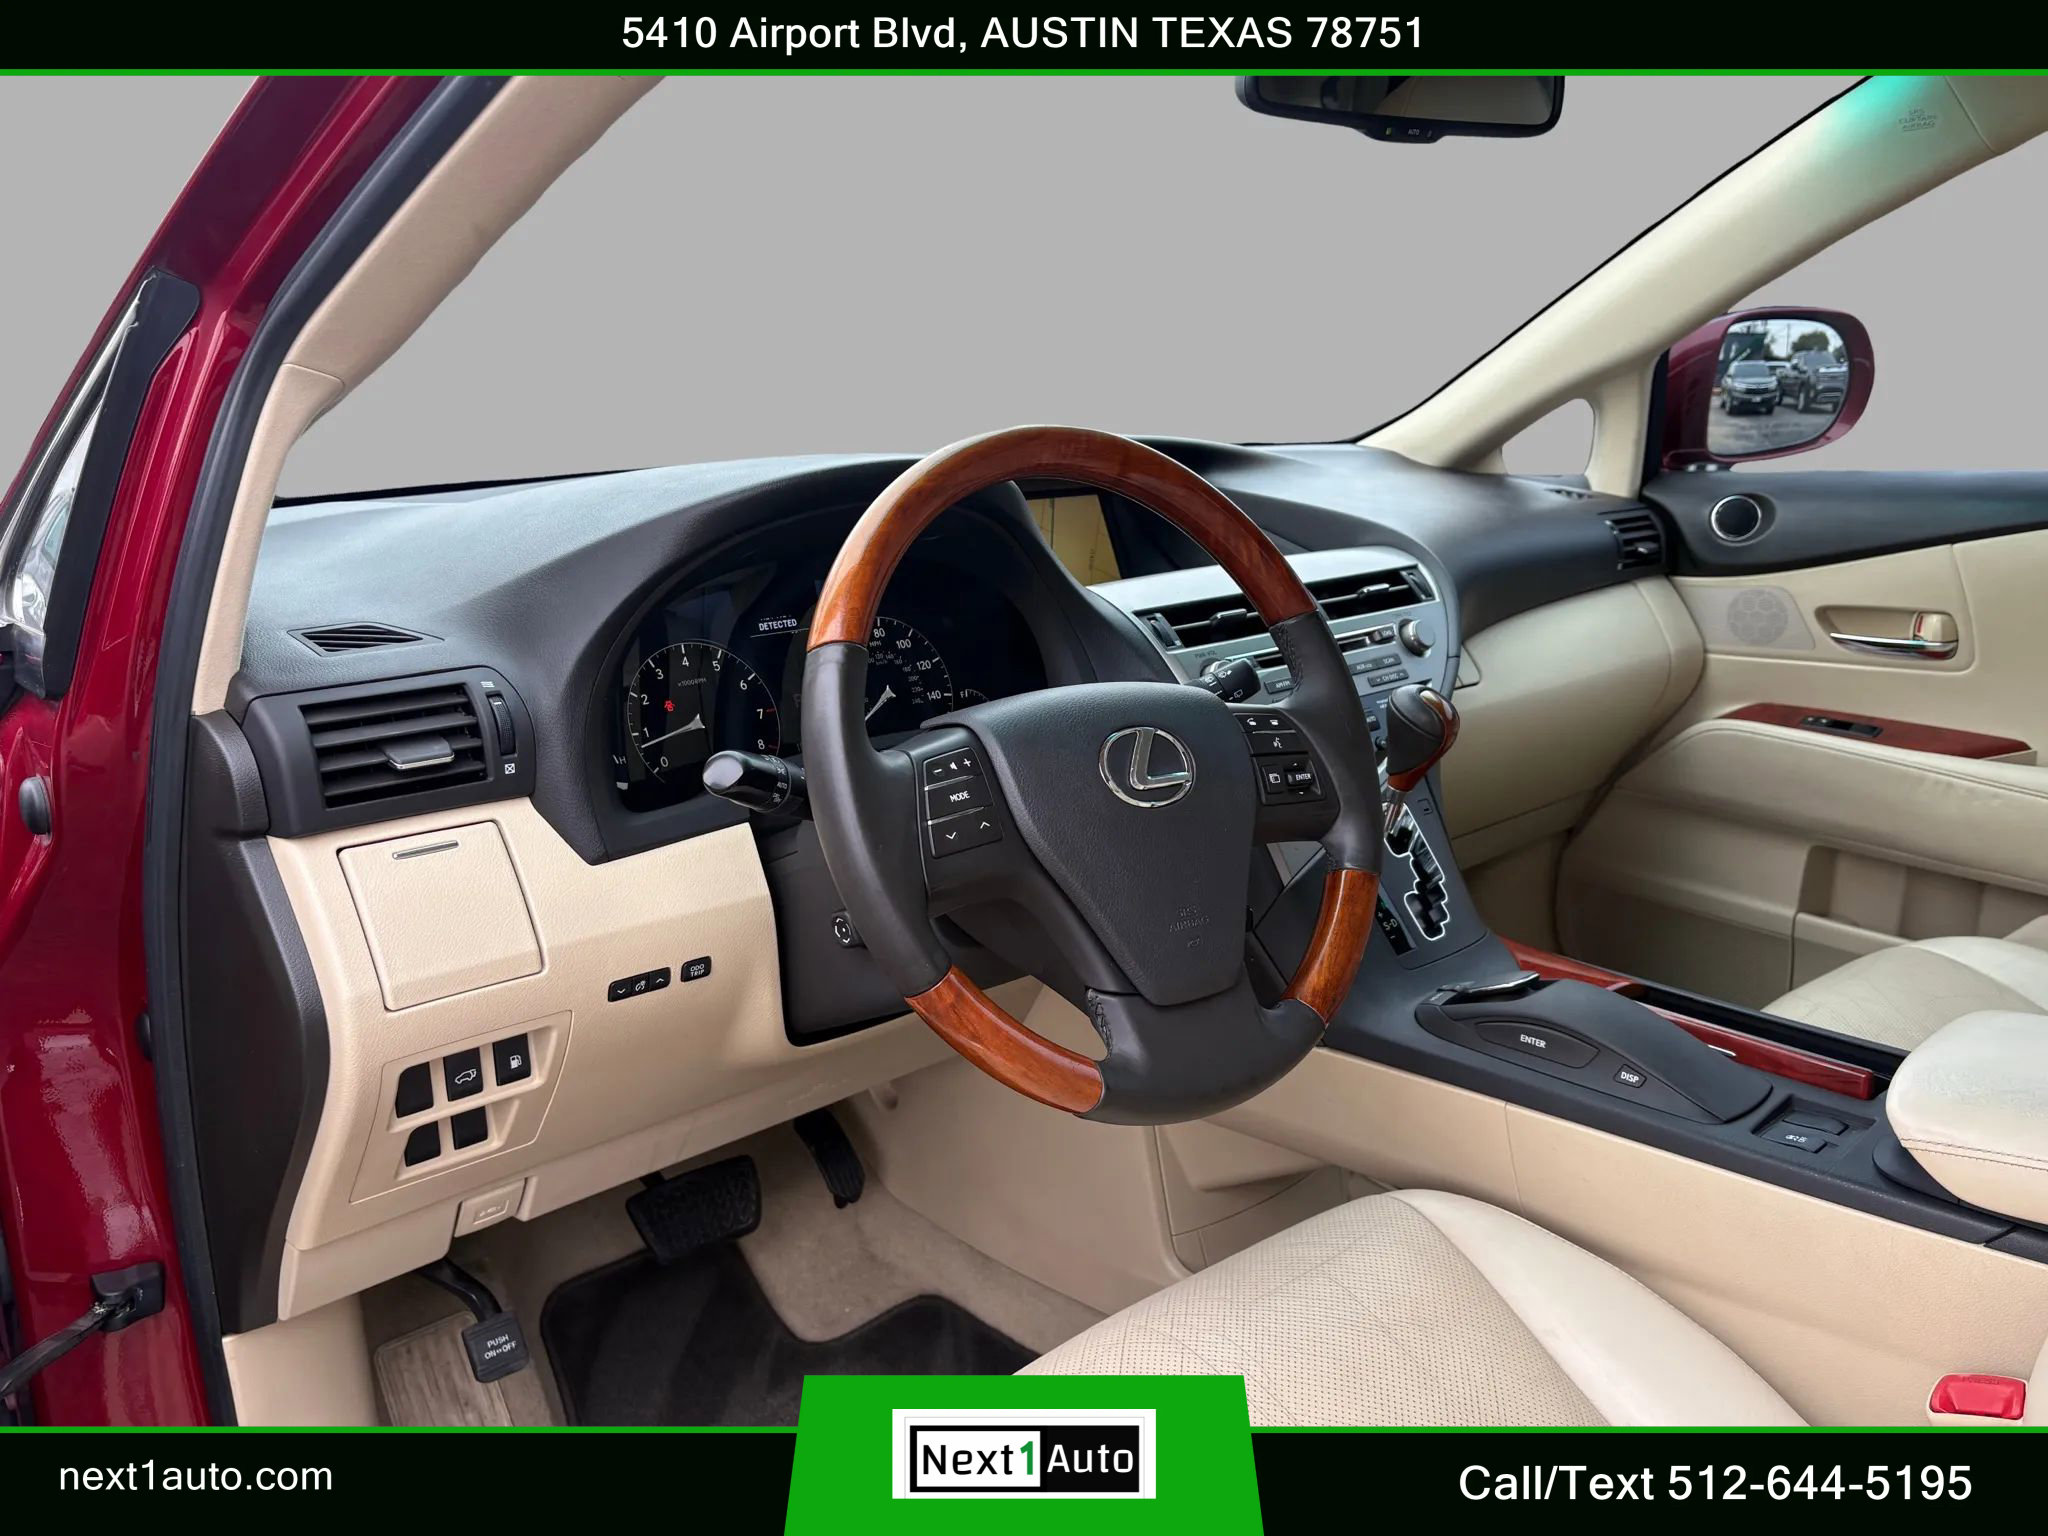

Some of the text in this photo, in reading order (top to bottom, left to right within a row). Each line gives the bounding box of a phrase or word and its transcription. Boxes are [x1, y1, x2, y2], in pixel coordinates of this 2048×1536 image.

[758, 618, 798, 631] DETECTED
[873, 627, 886, 639] 80
[896, 638, 912, 649] 100
[682, 656, 690, 667] 4
[712, 660, 721, 672] 5
[916, 659, 932, 671] 120
[655, 669, 664, 680] 3
[740, 680, 748, 691] 6
[640, 694, 650, 706] 2
[926, 690, 942, 701] 140
[756, 708, 764, 720] 7
[643, 727, 650, 738] 1
[757, 739, 765, 750] 8
[619, 755, 627, 765] H
[660, 756, 669, 767] 0
[1295, 773, 1311, 781] ENTER
[949, 790, 971, 802] MODE
[690, 963, 705, 972] ODO
[690, 969, 705, 977] TRIP
[1520, 1034, 1547, 1049] ENTER
[1620, 1071, 1640, 1083] DISP
[487, 1333, 509, 1348] PUSH
